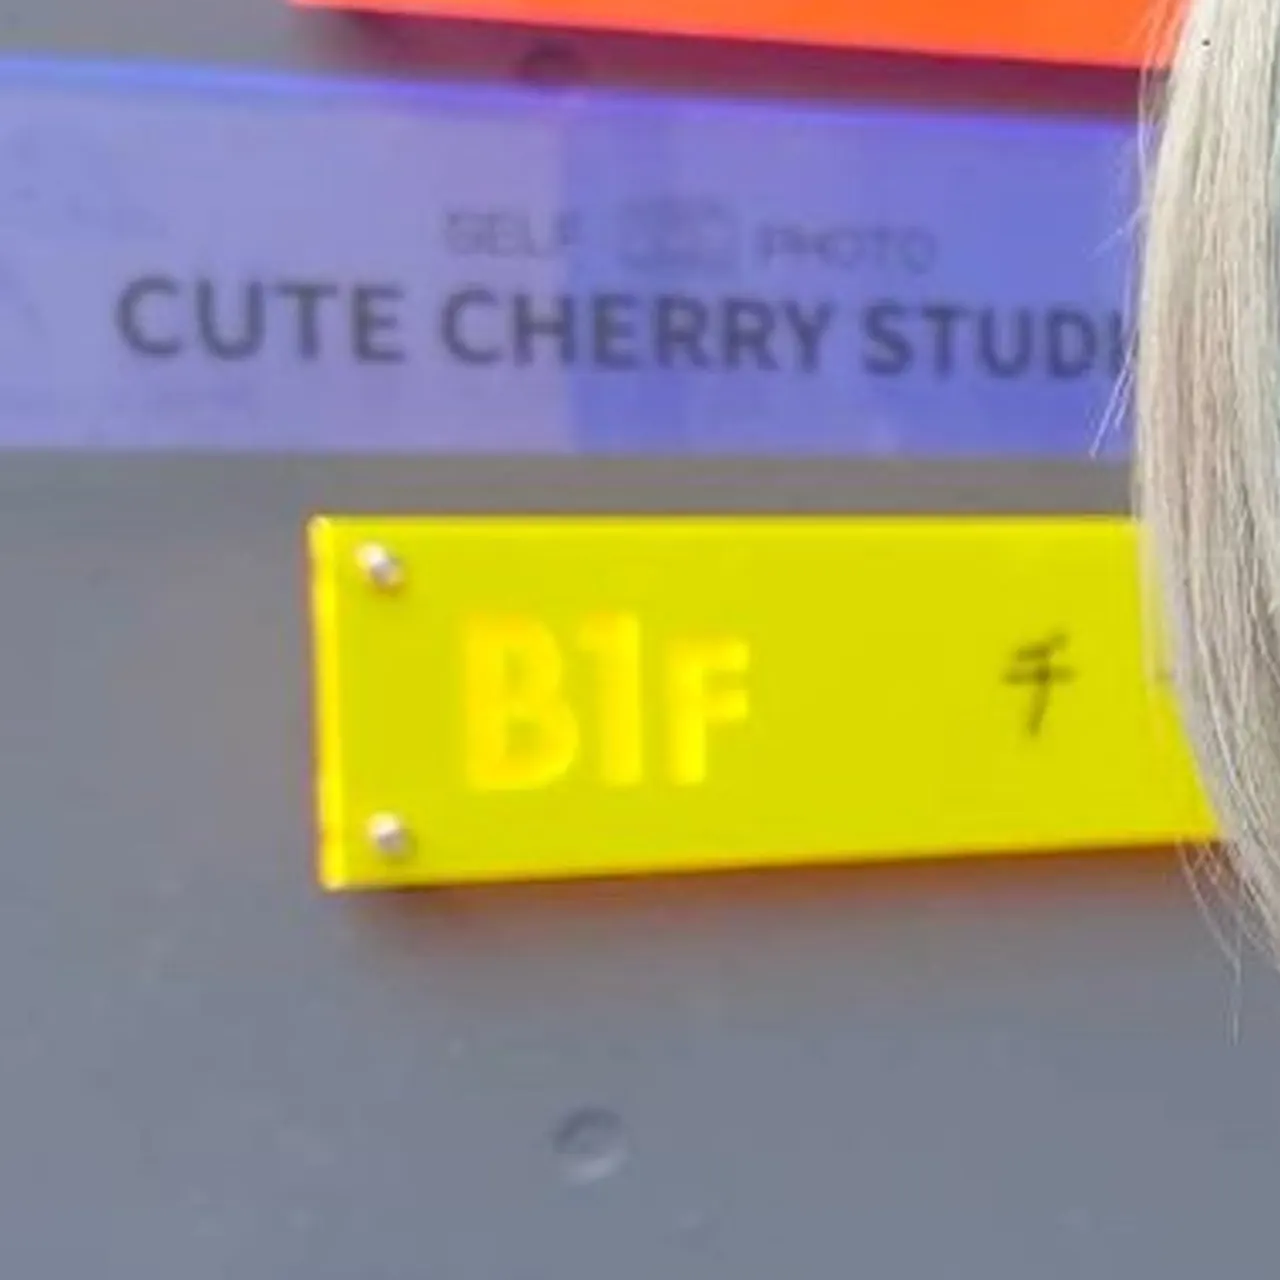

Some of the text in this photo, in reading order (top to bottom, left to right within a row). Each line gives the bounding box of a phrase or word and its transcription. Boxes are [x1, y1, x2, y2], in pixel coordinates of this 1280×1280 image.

[757, 221, 938, 274] PHOTO
[114, 276, 404, 366] CUTE
[440, 288, 832, 375] CHERRY
[459, 610, 752, 793] B1F
